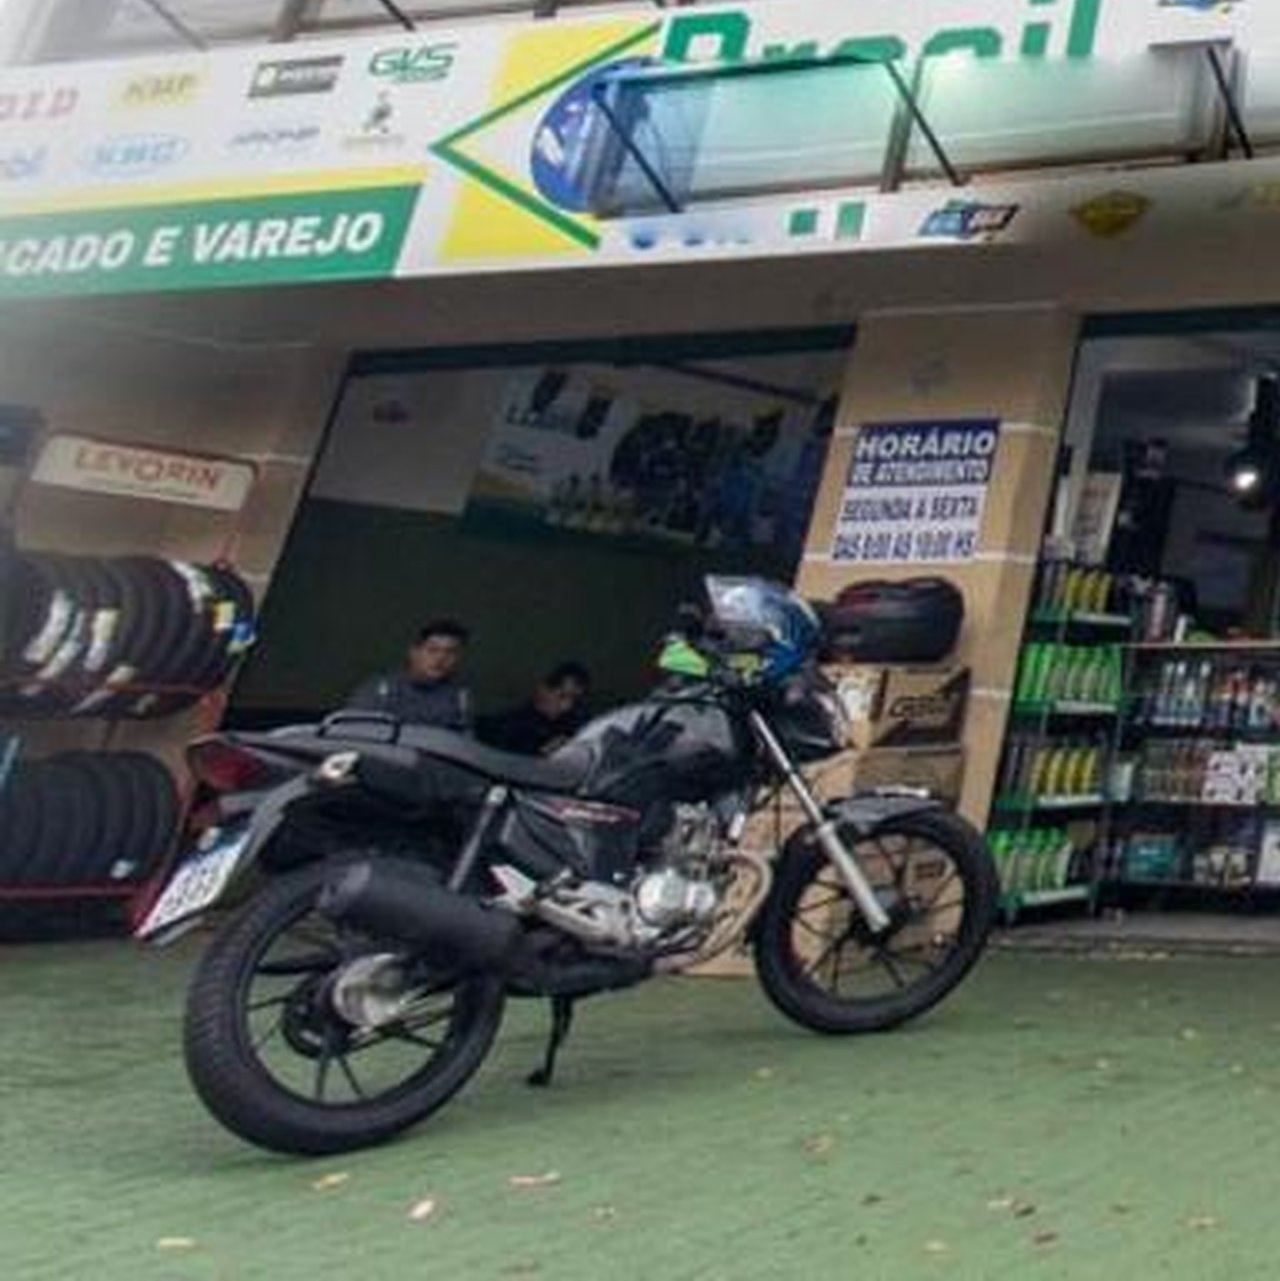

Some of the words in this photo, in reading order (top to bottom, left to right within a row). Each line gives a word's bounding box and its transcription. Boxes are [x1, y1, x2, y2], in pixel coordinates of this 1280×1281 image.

[143, 226, 183, 267] E
[192, 212, 385, 264] VAREJO
[855, 427, 997, 459] HORÁRIO
